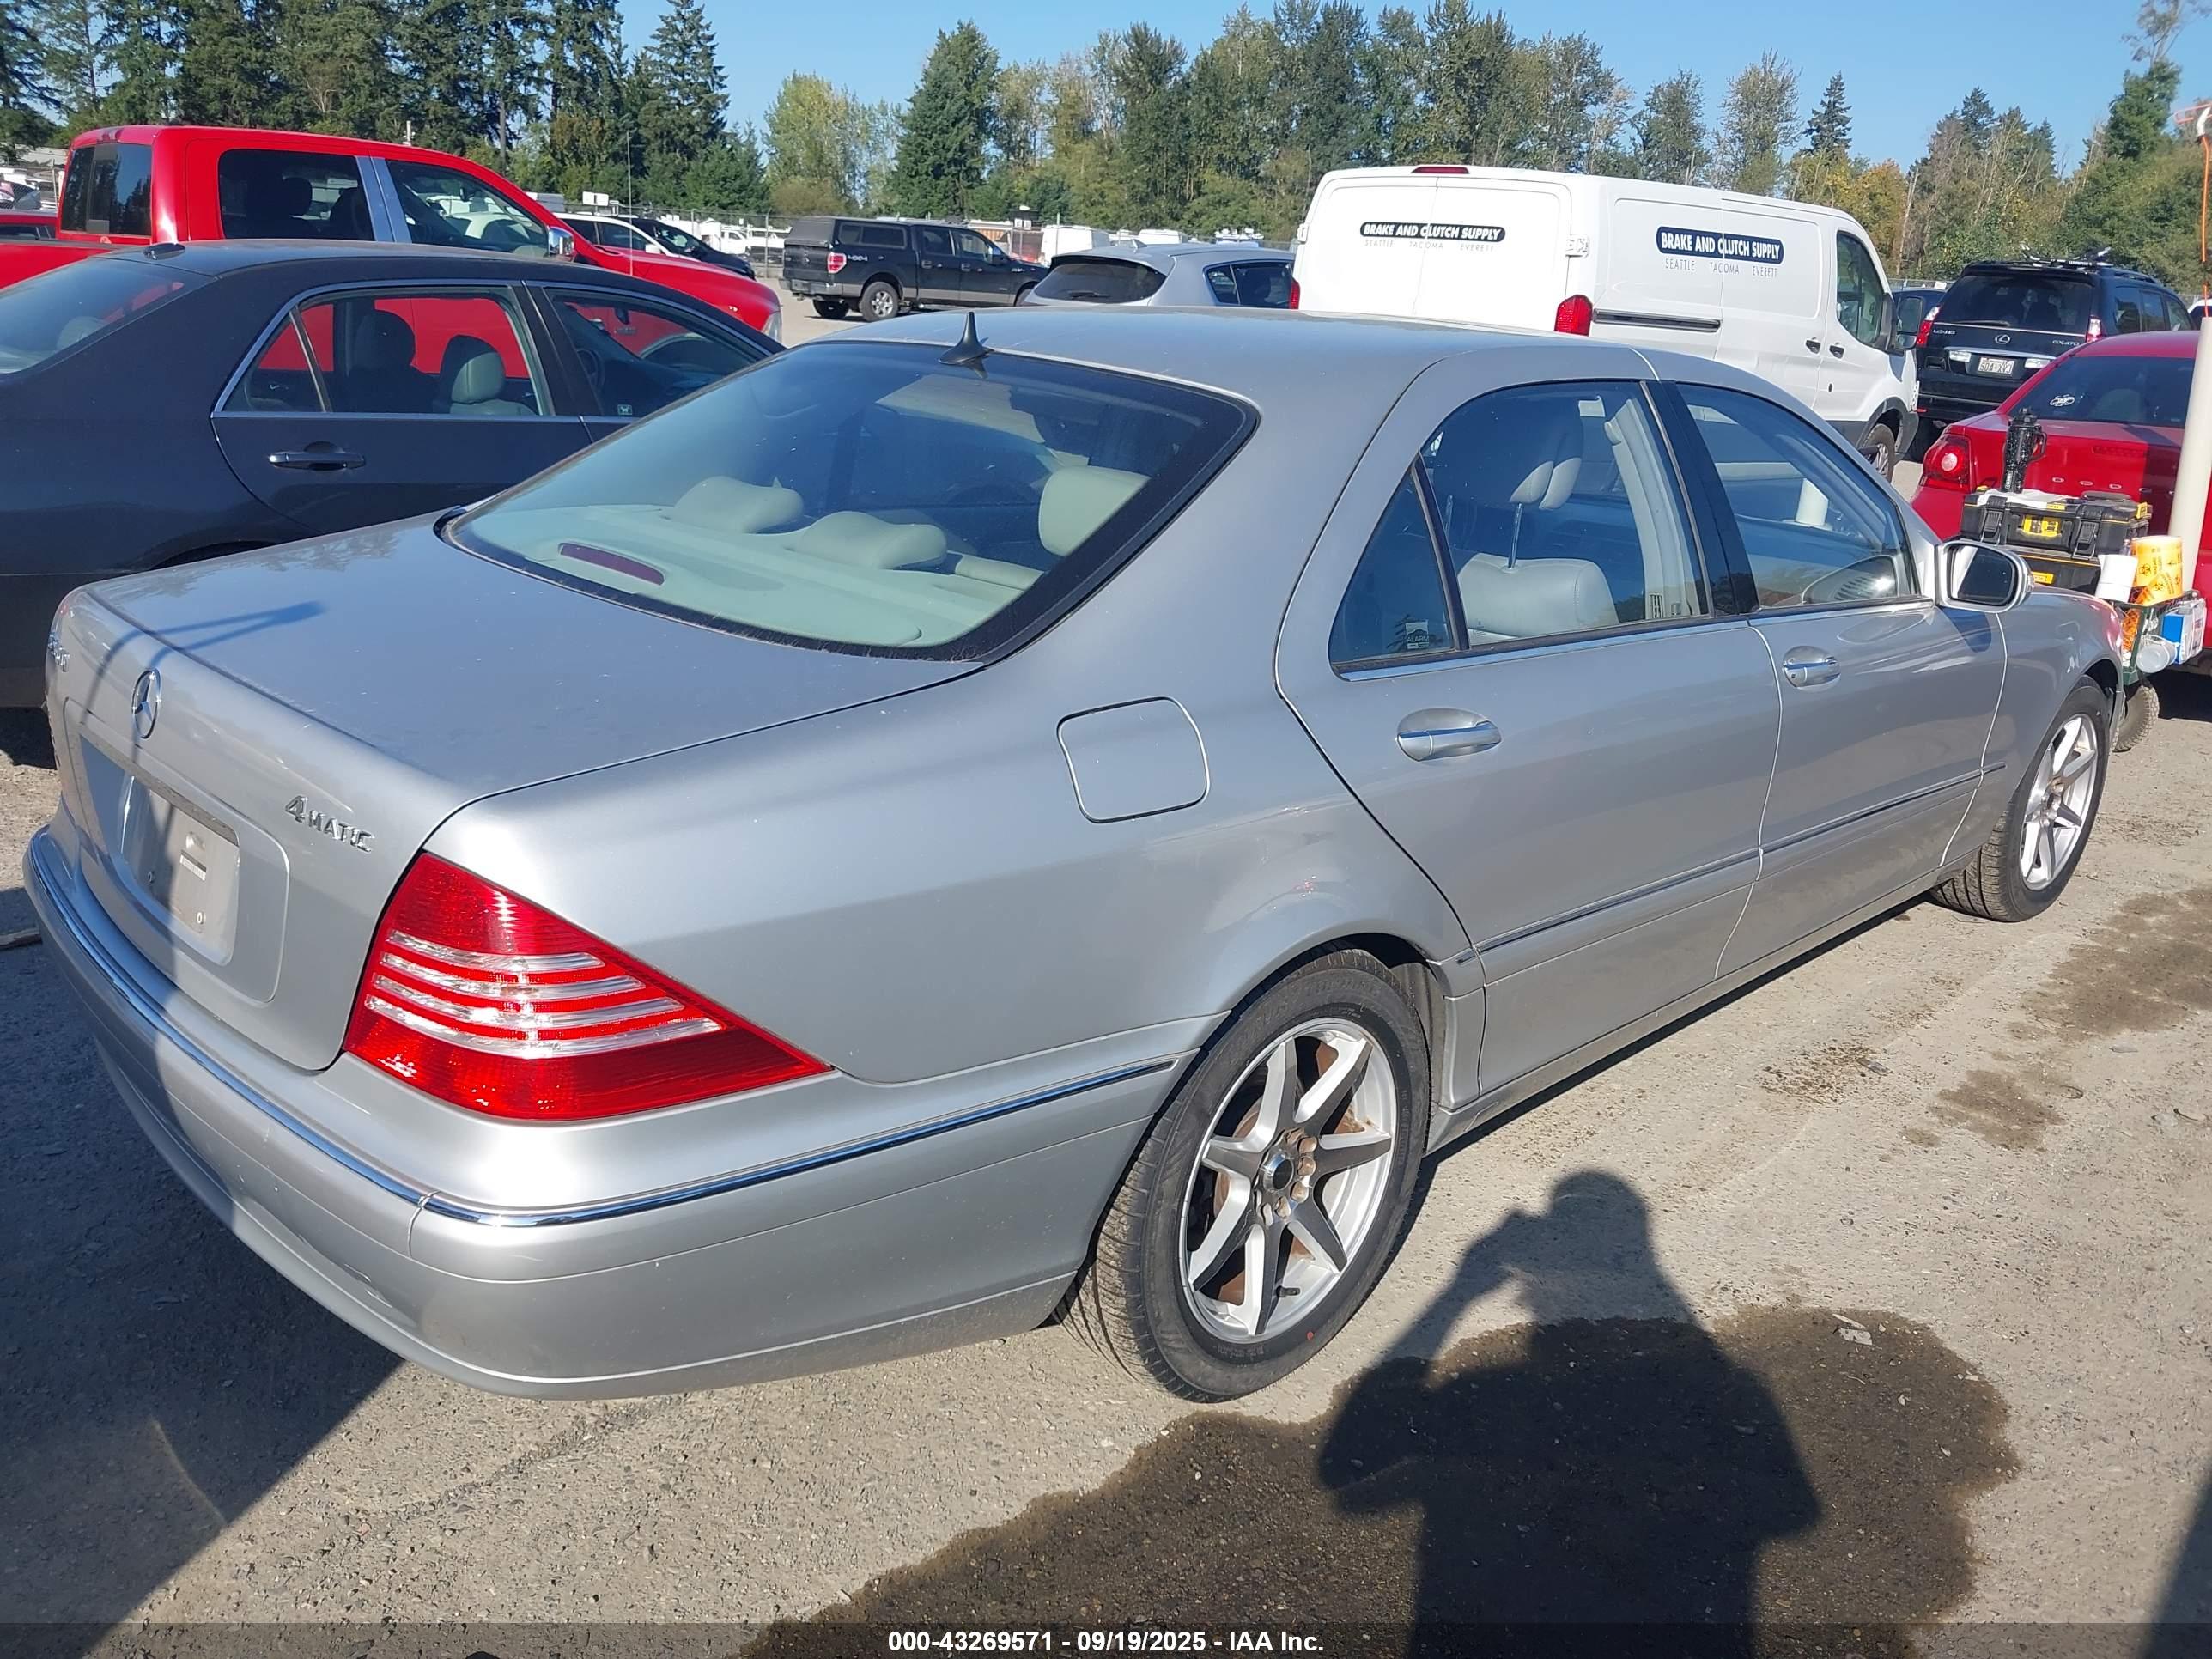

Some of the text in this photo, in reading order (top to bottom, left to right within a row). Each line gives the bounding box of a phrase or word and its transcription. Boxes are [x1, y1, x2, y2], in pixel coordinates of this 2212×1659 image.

[1364, 223, 1502, 240] BRAKE AND CLUTCH SUPPLY
[1364, 240, 1395, 248] SEATTLE
[1460, 244, 1495, 252] EVERETT
[1661, 232, 1780, 260] BRAKE AND CLUTCH SUPPLY
[1665, 258, 1778, 278] SEATTLE TACOMA EVERETT
[285, 795, 375, 852] 4MATIC
